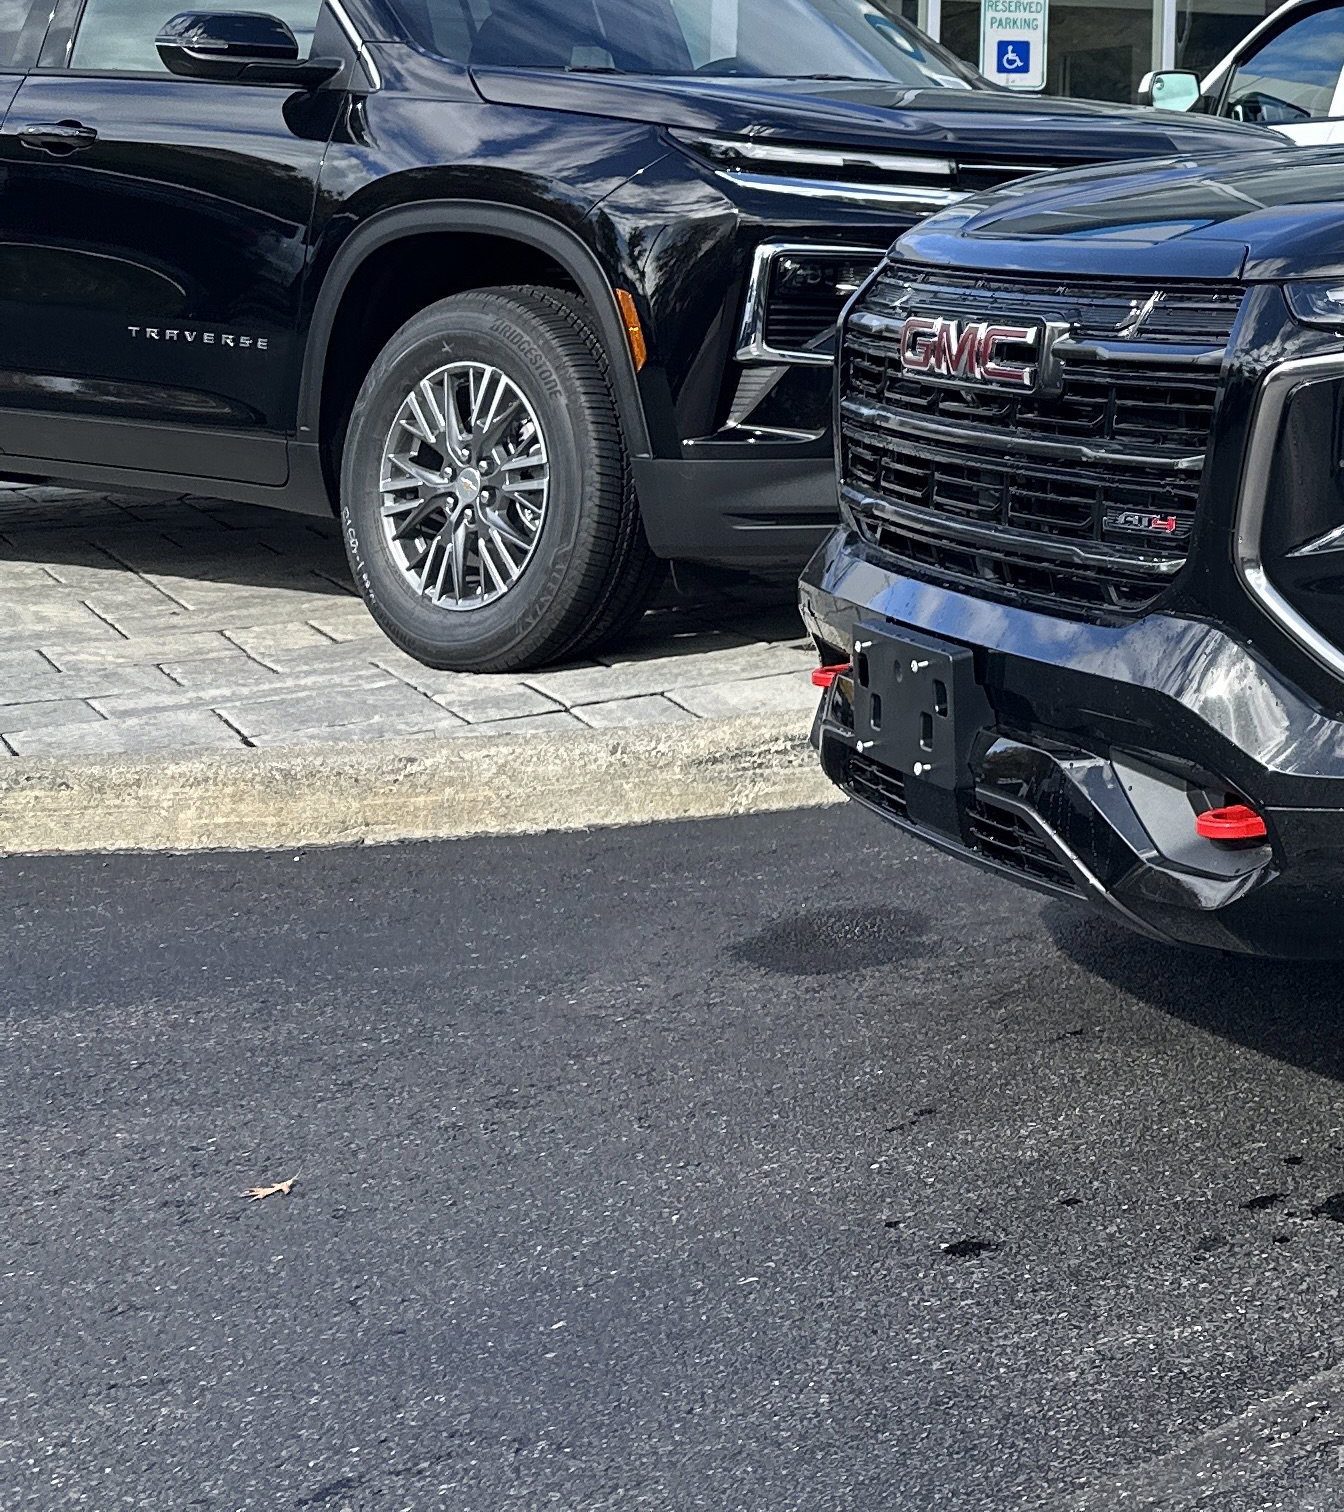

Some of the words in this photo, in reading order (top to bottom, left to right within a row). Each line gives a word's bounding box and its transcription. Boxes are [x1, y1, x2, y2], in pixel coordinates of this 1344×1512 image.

[986, 0, 1043, 14] RESERVED
[990, 17, 1039, 31] PARKING
[127, 326, 269, 350] TRAVERSE
[488, 318, 563, 400] BRIDGESTONE
[901, 316, 1038, 387] GMC
[1116, 511, 1177, 534] AT4
